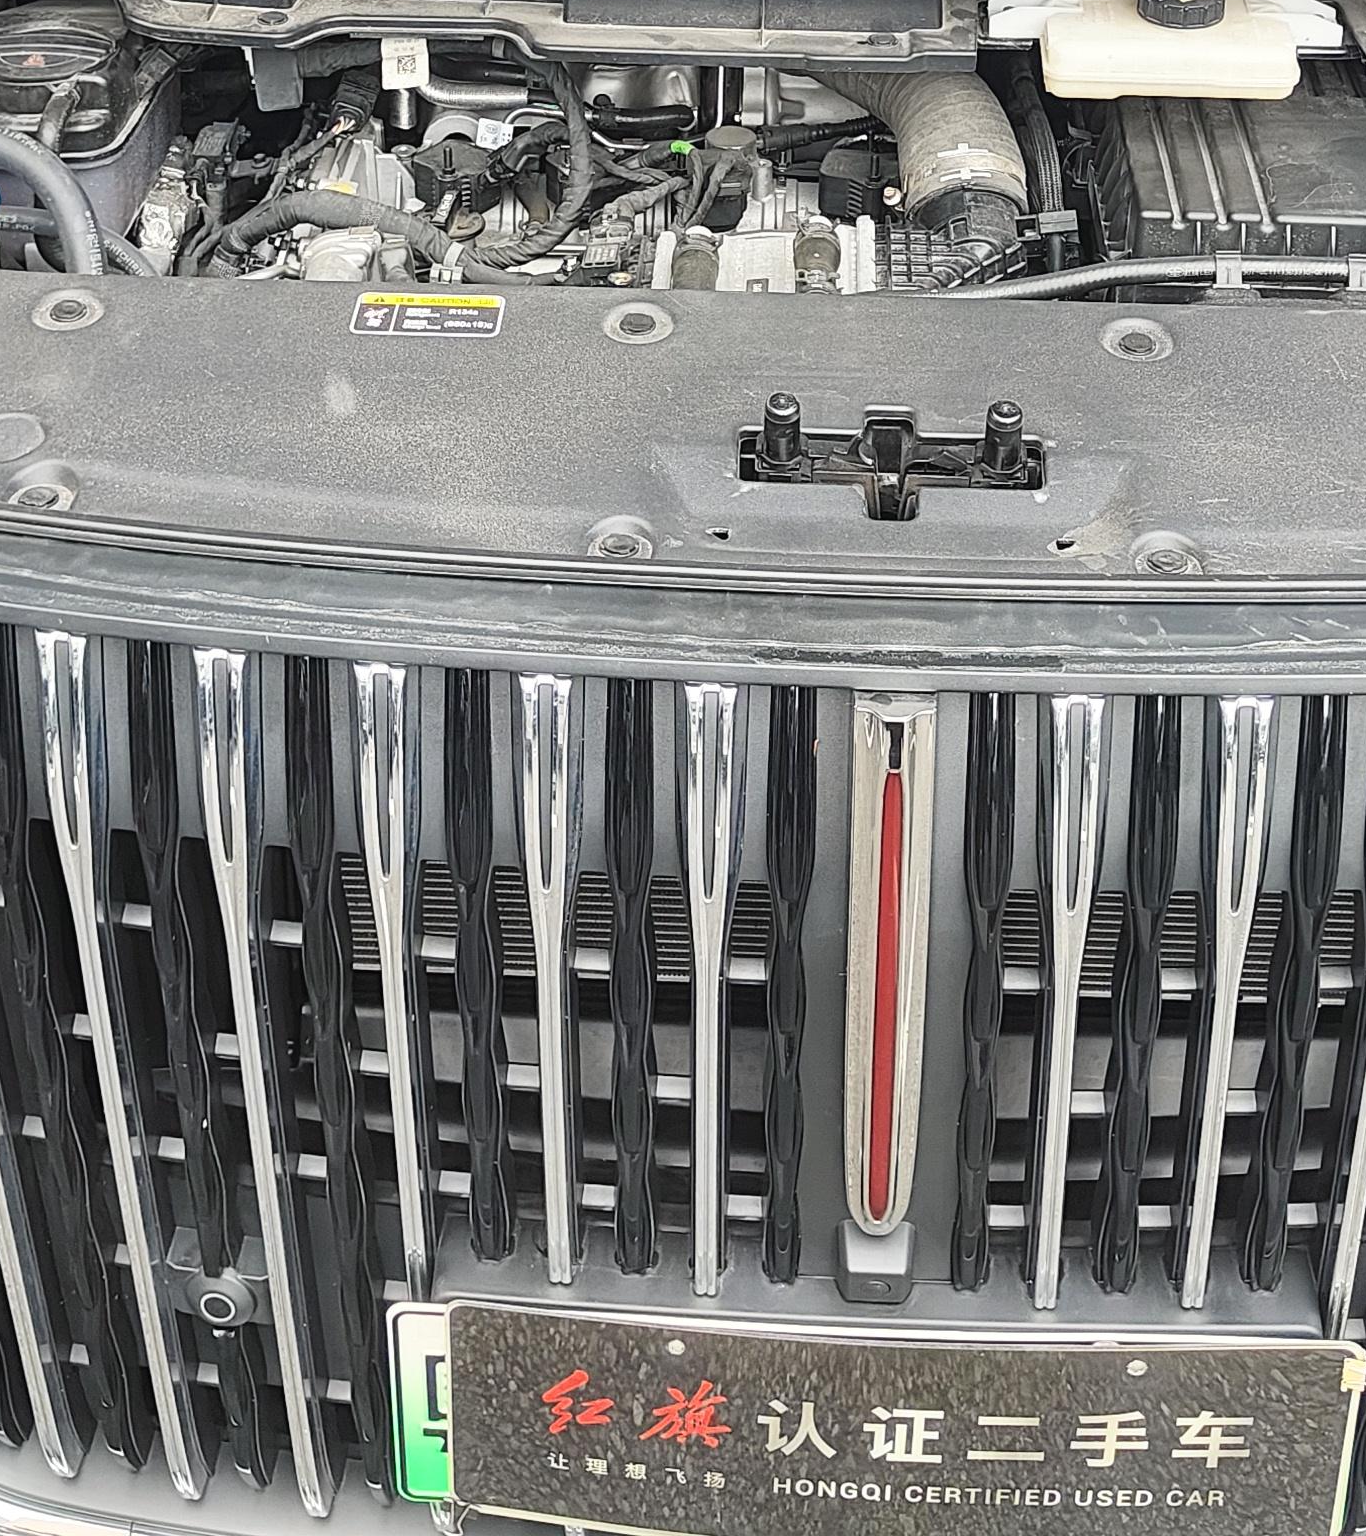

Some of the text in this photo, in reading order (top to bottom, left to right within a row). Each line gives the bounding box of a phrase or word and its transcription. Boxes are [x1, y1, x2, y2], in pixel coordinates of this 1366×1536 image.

[541, 1369, 1254, 1469] 红旗 认证二手车
[546, 1451, 726, 1490] 让理想飞扬
[771, 1476, 1226, 1508] HONGQI CERTIFIED USED CAR
